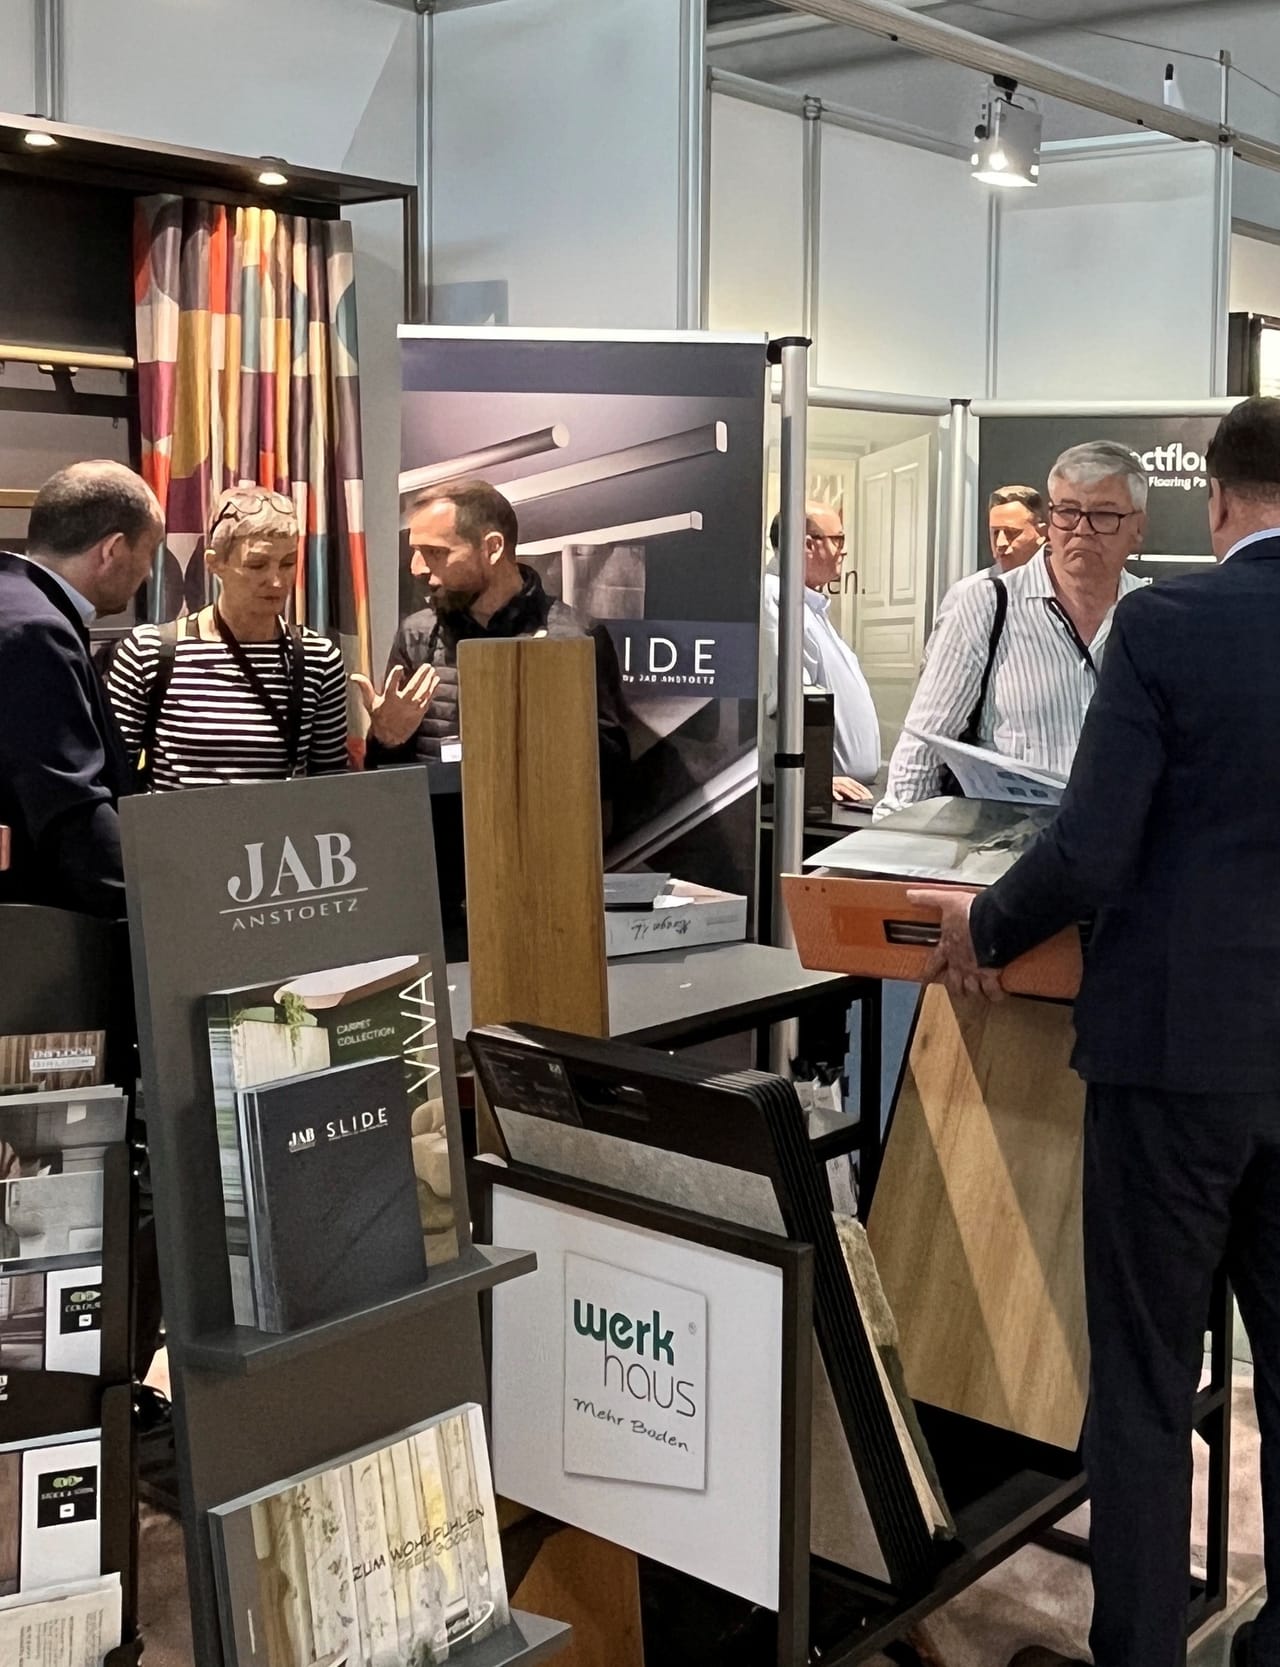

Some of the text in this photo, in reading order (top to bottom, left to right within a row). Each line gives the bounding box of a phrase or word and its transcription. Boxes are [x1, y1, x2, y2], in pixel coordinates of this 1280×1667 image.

[1148, 476, 1191, 490] Flooring
[625, 637, 716, 674] IDE
[227, 832, 357, 903] JAB
[231, 898, 358, 932] ANSTOETZ
[336, 1018, 372, 1035] CARPET
[337, 1026, 396, 1047] COLLECTION
[398, 971, 441, 1093] VIVA
[288, 1107, 388, 1147] JAB SLIDE
[574, 1298, 675, 1367] werk
[603, 1340, 696, 1418] haus
[573, 1398, 625, 1426] Mehr
[352, 1553, 387, 1582] ZUM
